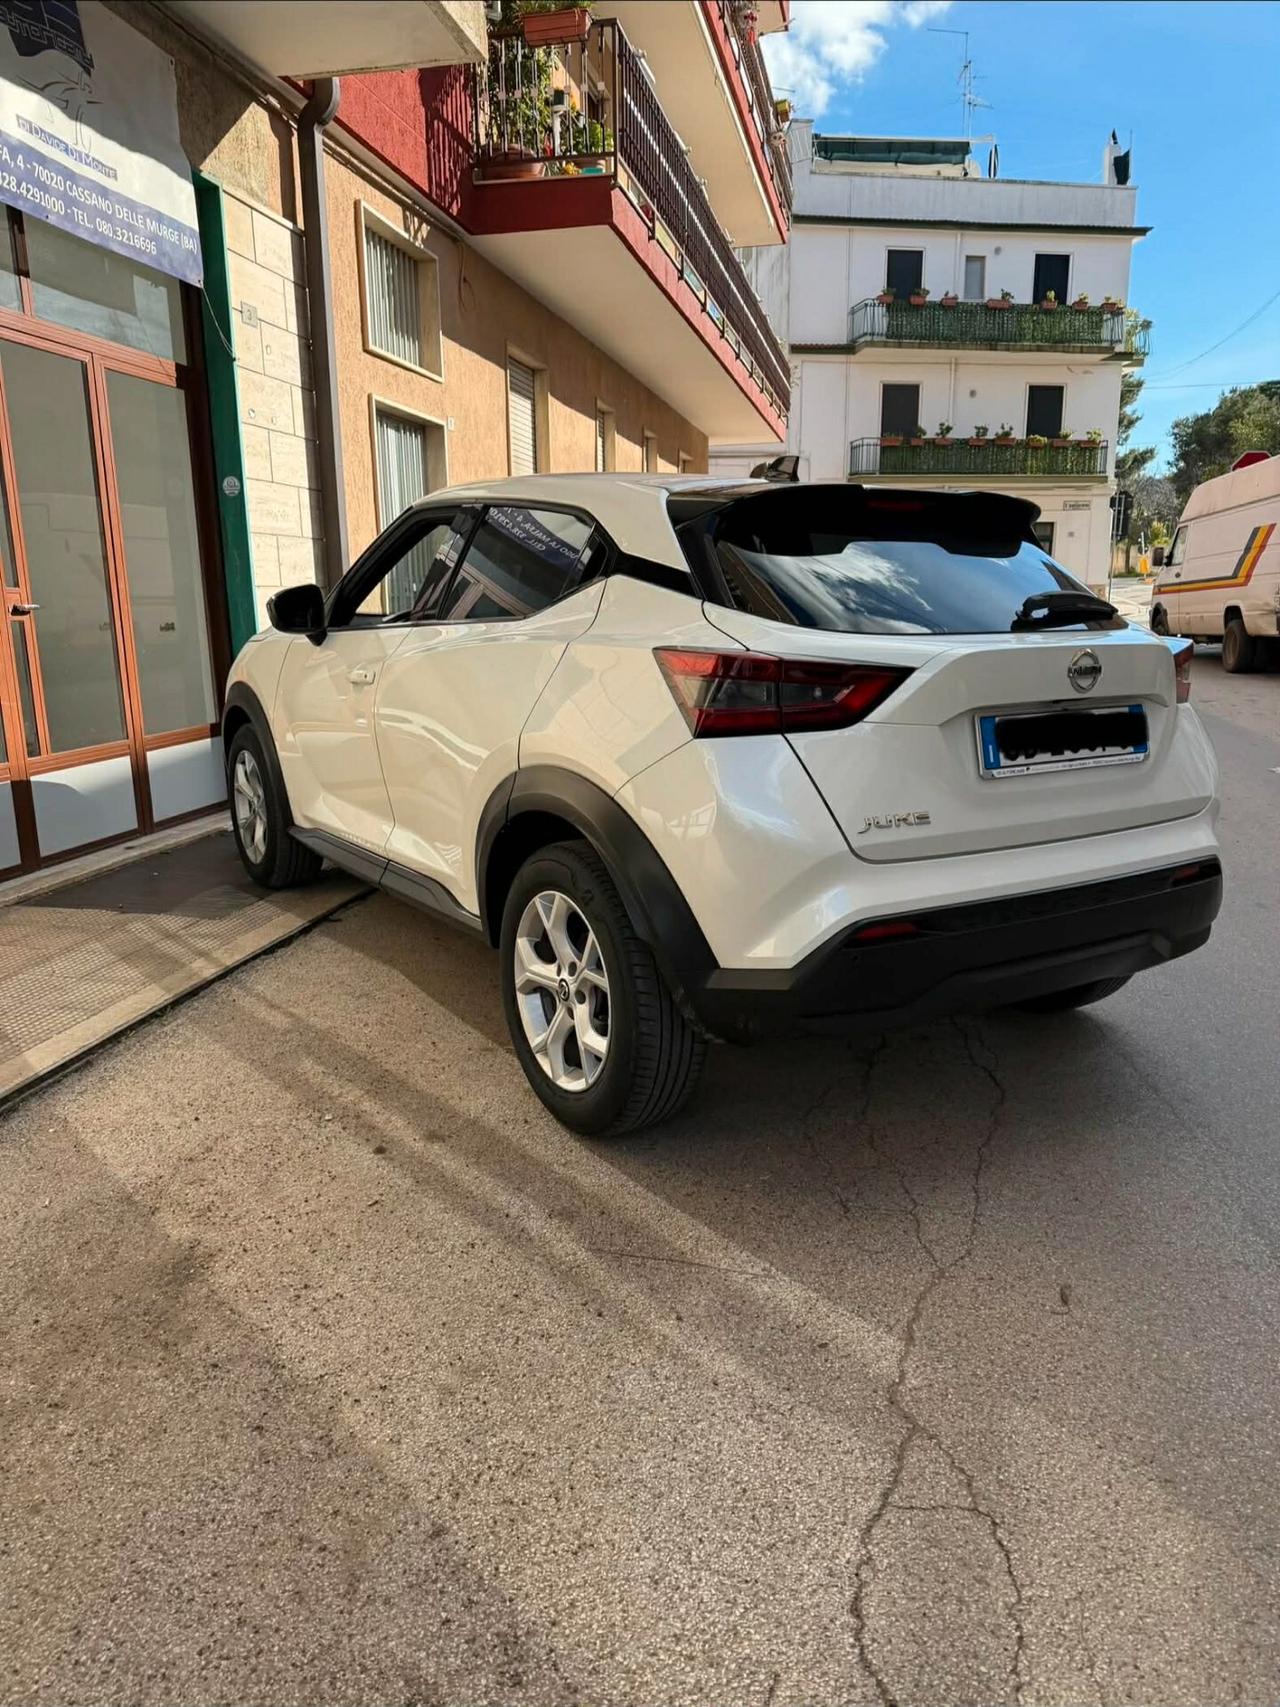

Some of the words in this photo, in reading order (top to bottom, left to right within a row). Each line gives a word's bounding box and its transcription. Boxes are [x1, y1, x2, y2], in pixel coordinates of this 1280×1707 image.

[0, 170, 65, 215] 28.4291000
[72, 206, 94, 229] TEL.
[95, 217, 157, 255] 080.3216696
[16, 154, 24, 170] 4
[32, 161, 65, 191] 70020
[66, 180, 113, 215] CASSANO
[115, 204, 145, 228] DELLE
[146, 218, 179, 244] MURGE
[180, 232, 197, 255] (BA)
[857, 811, 932, 834] JUKE
